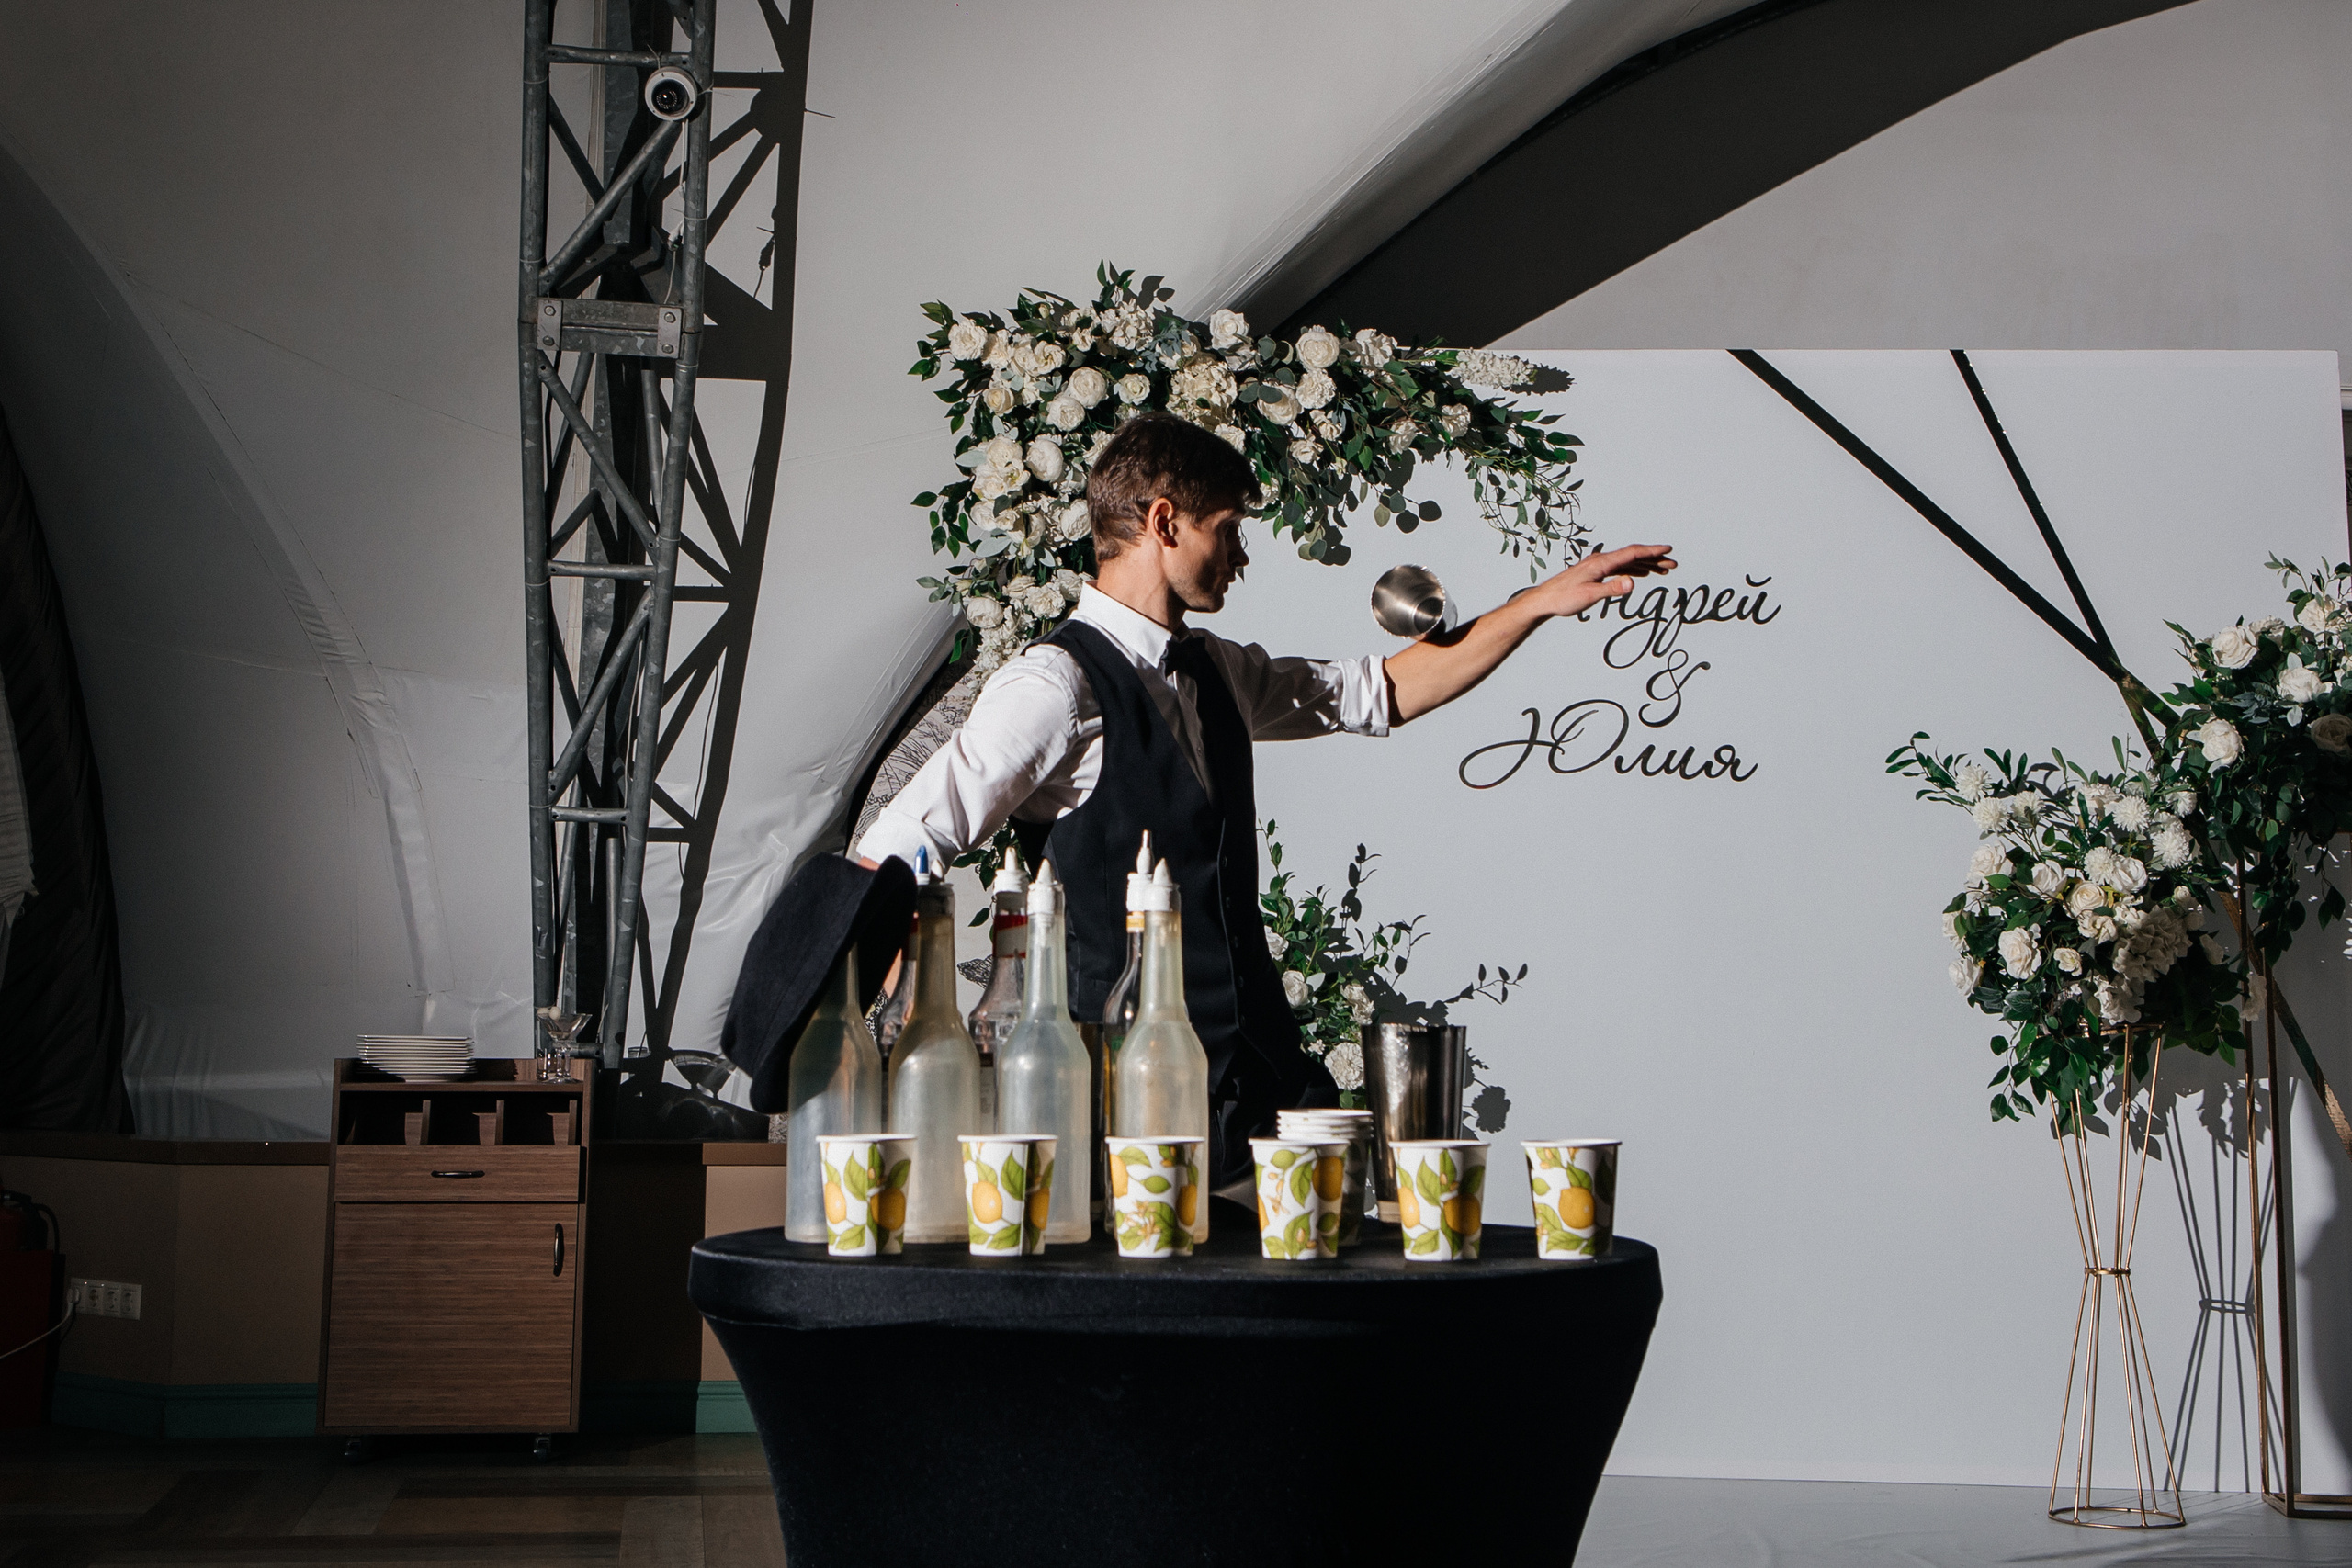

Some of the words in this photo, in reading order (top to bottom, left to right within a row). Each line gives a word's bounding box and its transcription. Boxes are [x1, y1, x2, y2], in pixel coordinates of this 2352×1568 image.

[1507, 542, 1781, 670] ндрей
[1638, 649, 1711, 728] &
[1458, 699, 1758, 790] Юлия
